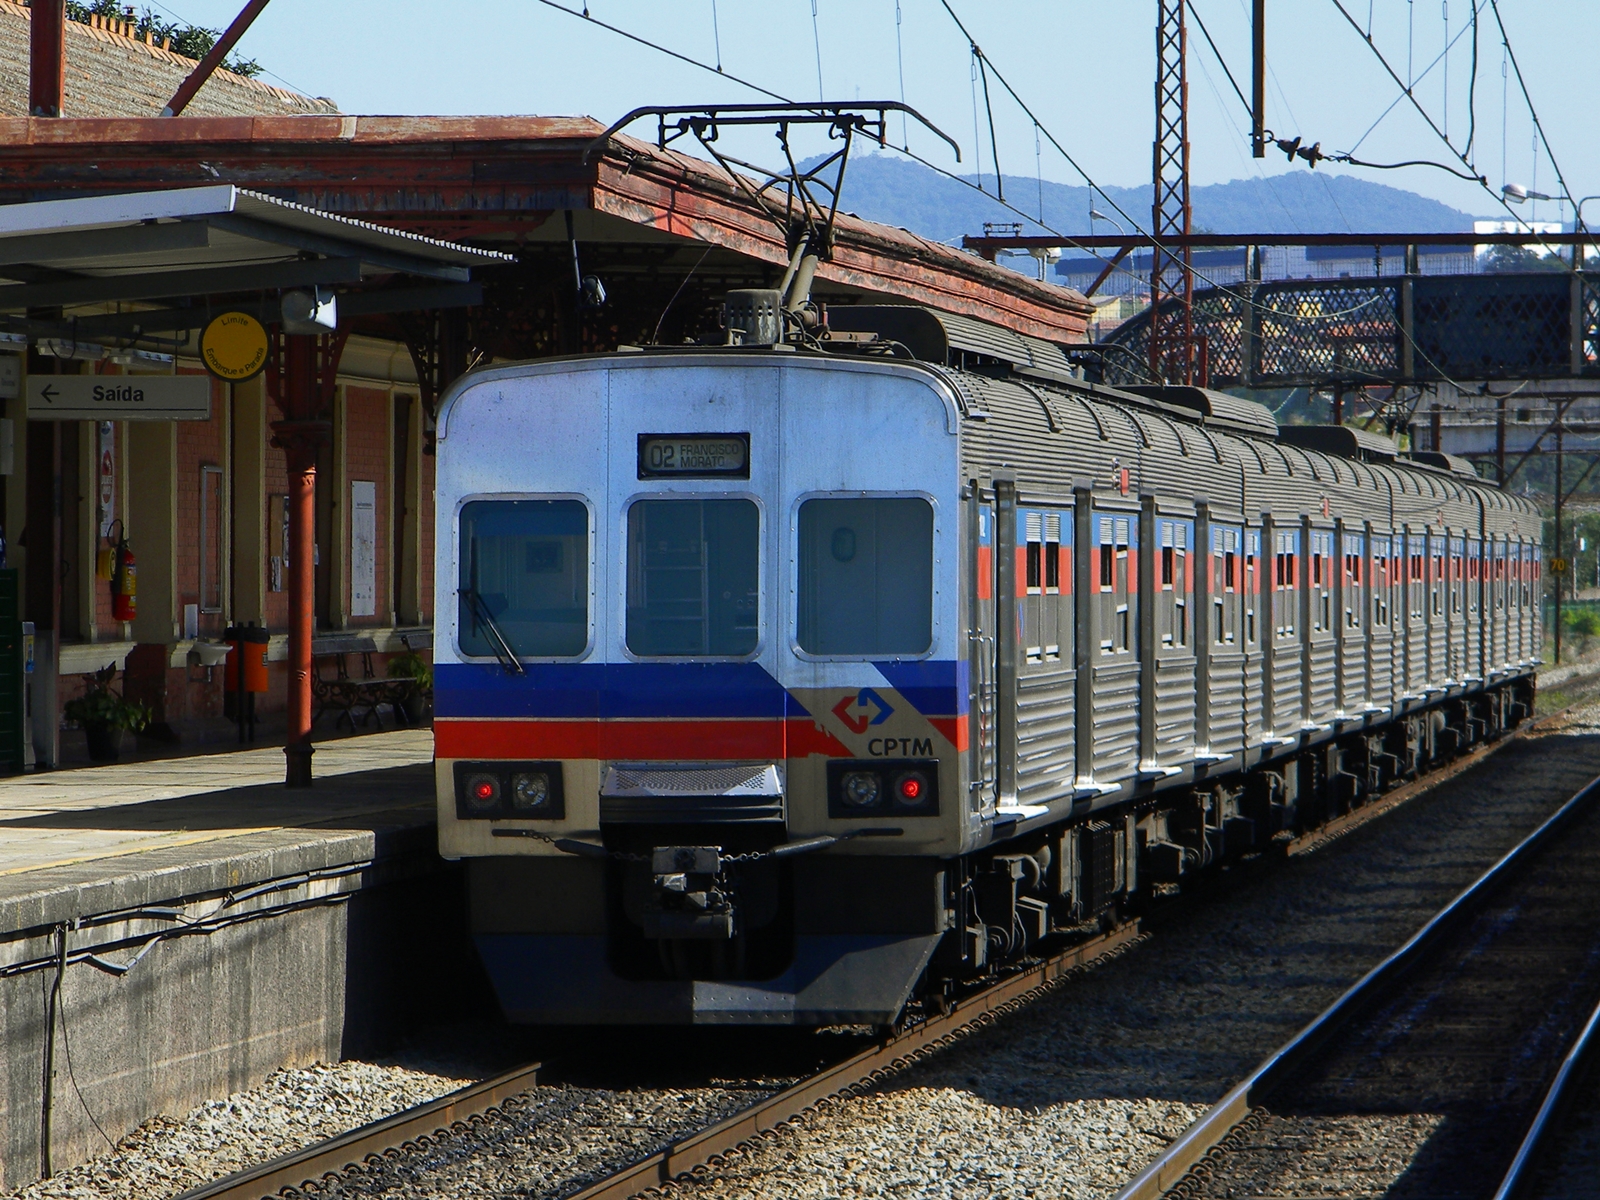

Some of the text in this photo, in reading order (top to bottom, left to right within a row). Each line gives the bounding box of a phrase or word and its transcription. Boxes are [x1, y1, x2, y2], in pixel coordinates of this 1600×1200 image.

[221, 316, 249, 326] Limite
[206, 347, 238, 375] Embarque
[244, 347, 264, 371] Parada
[92, 385, 144, 402] Saída
[650, 444, 675, 468] 02
[680, 443, 739, 456] FRANCISCO
[680, 456, 725, 468] MORATO
[1551, 559, 1565, 571] 70
[868, 738, 933, 756] CPTM
